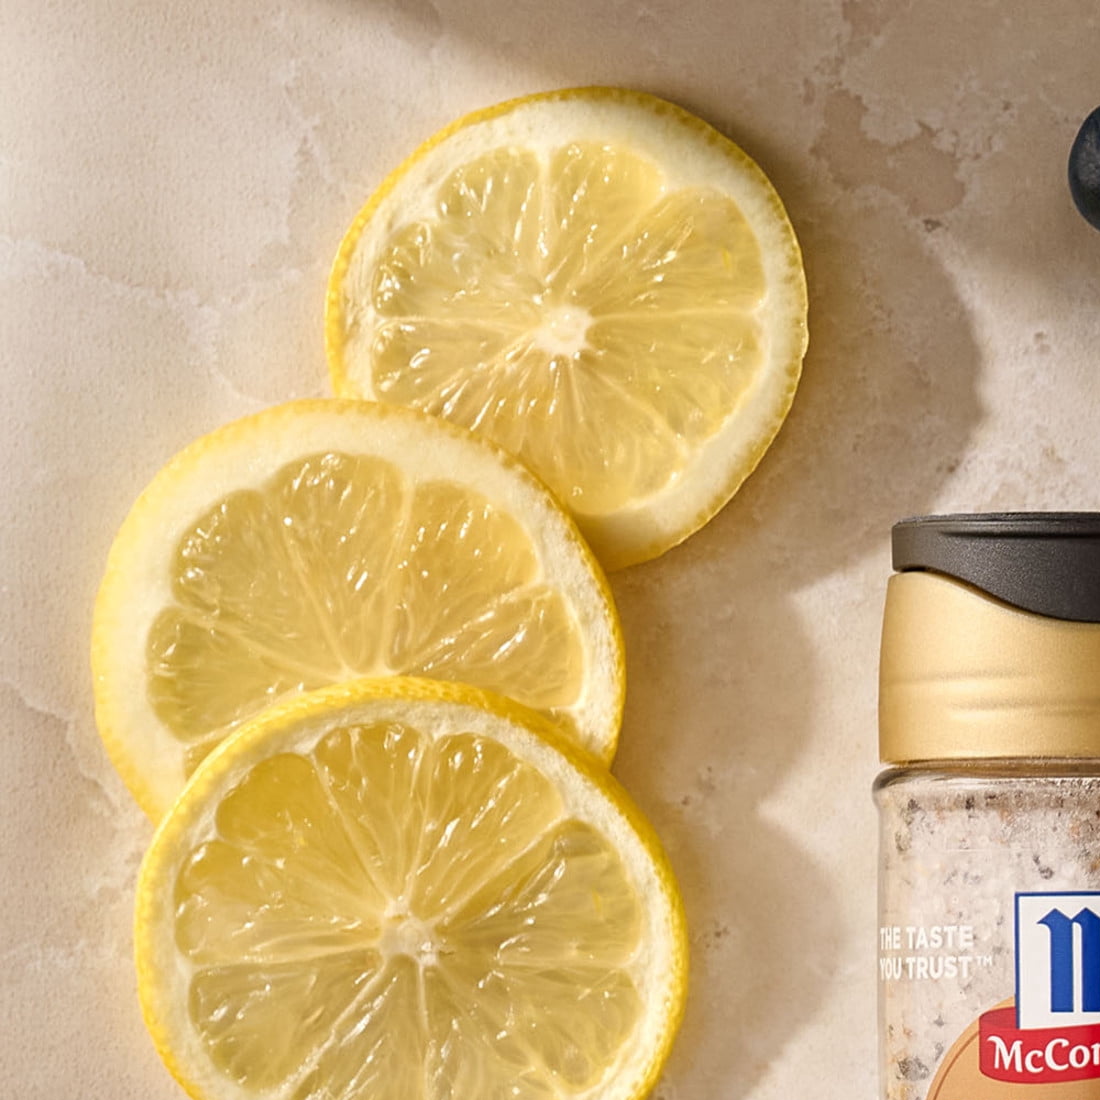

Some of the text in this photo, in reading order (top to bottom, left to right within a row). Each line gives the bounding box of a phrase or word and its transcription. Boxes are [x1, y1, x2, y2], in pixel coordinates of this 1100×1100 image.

[880, 926, 974, 950] THE TASTE
[880, 958, 903, 980] YOU
